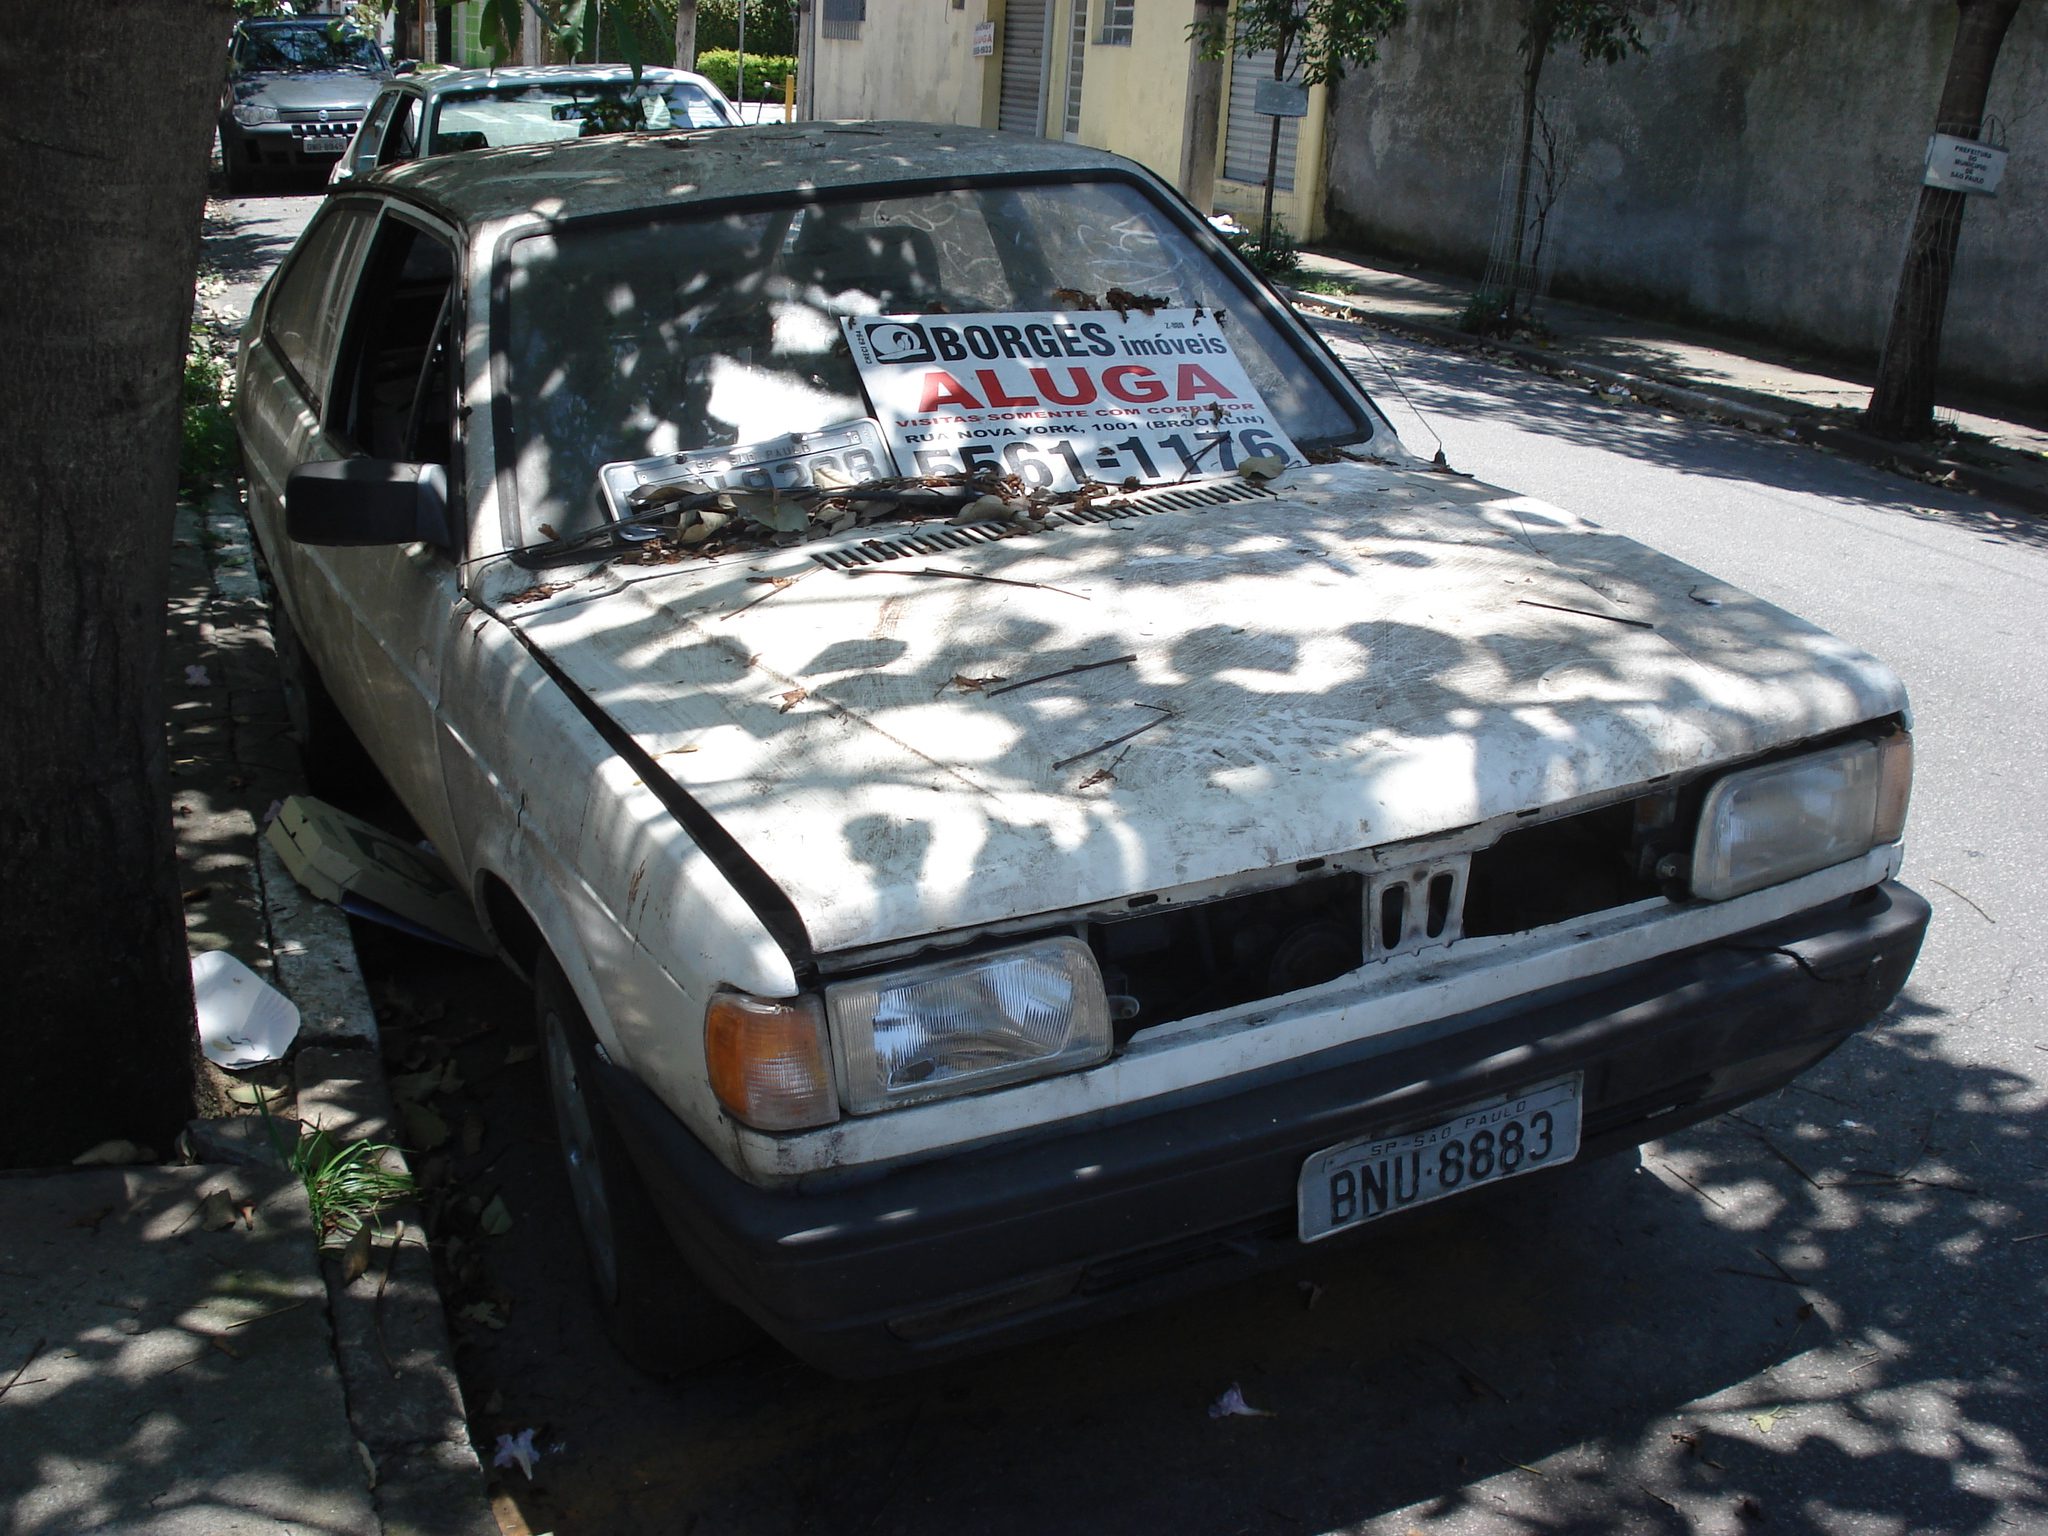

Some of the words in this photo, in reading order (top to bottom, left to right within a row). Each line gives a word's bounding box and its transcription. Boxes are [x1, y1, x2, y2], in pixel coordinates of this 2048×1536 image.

[1954, 145, 1992, 159] PREFEITURA
[1964, 175, 1985, 185] PAULO
[930, 323, 1116, 361] BORGES
[1120, 333, 1228, 357] imóveis
[860, 346, 873, 365] CRECI
[920, 363, 1238, 412] ALUGA
[895, 414, 982, 428] VISITAS
[987, 409, 1087, 421] SOMENTE
[1095, 408, 1141, 418] COM
[904, 433, 950, 444] RUA
[957, 427, 1015, 440] NOVA
[1019, 424, 1086, 435] YORK,
[1091, 422, 1138, 432] 1001
[913, 428, 1291, 490] 5561-1176
[1464, 1100, 1527, 1129] PAULO
